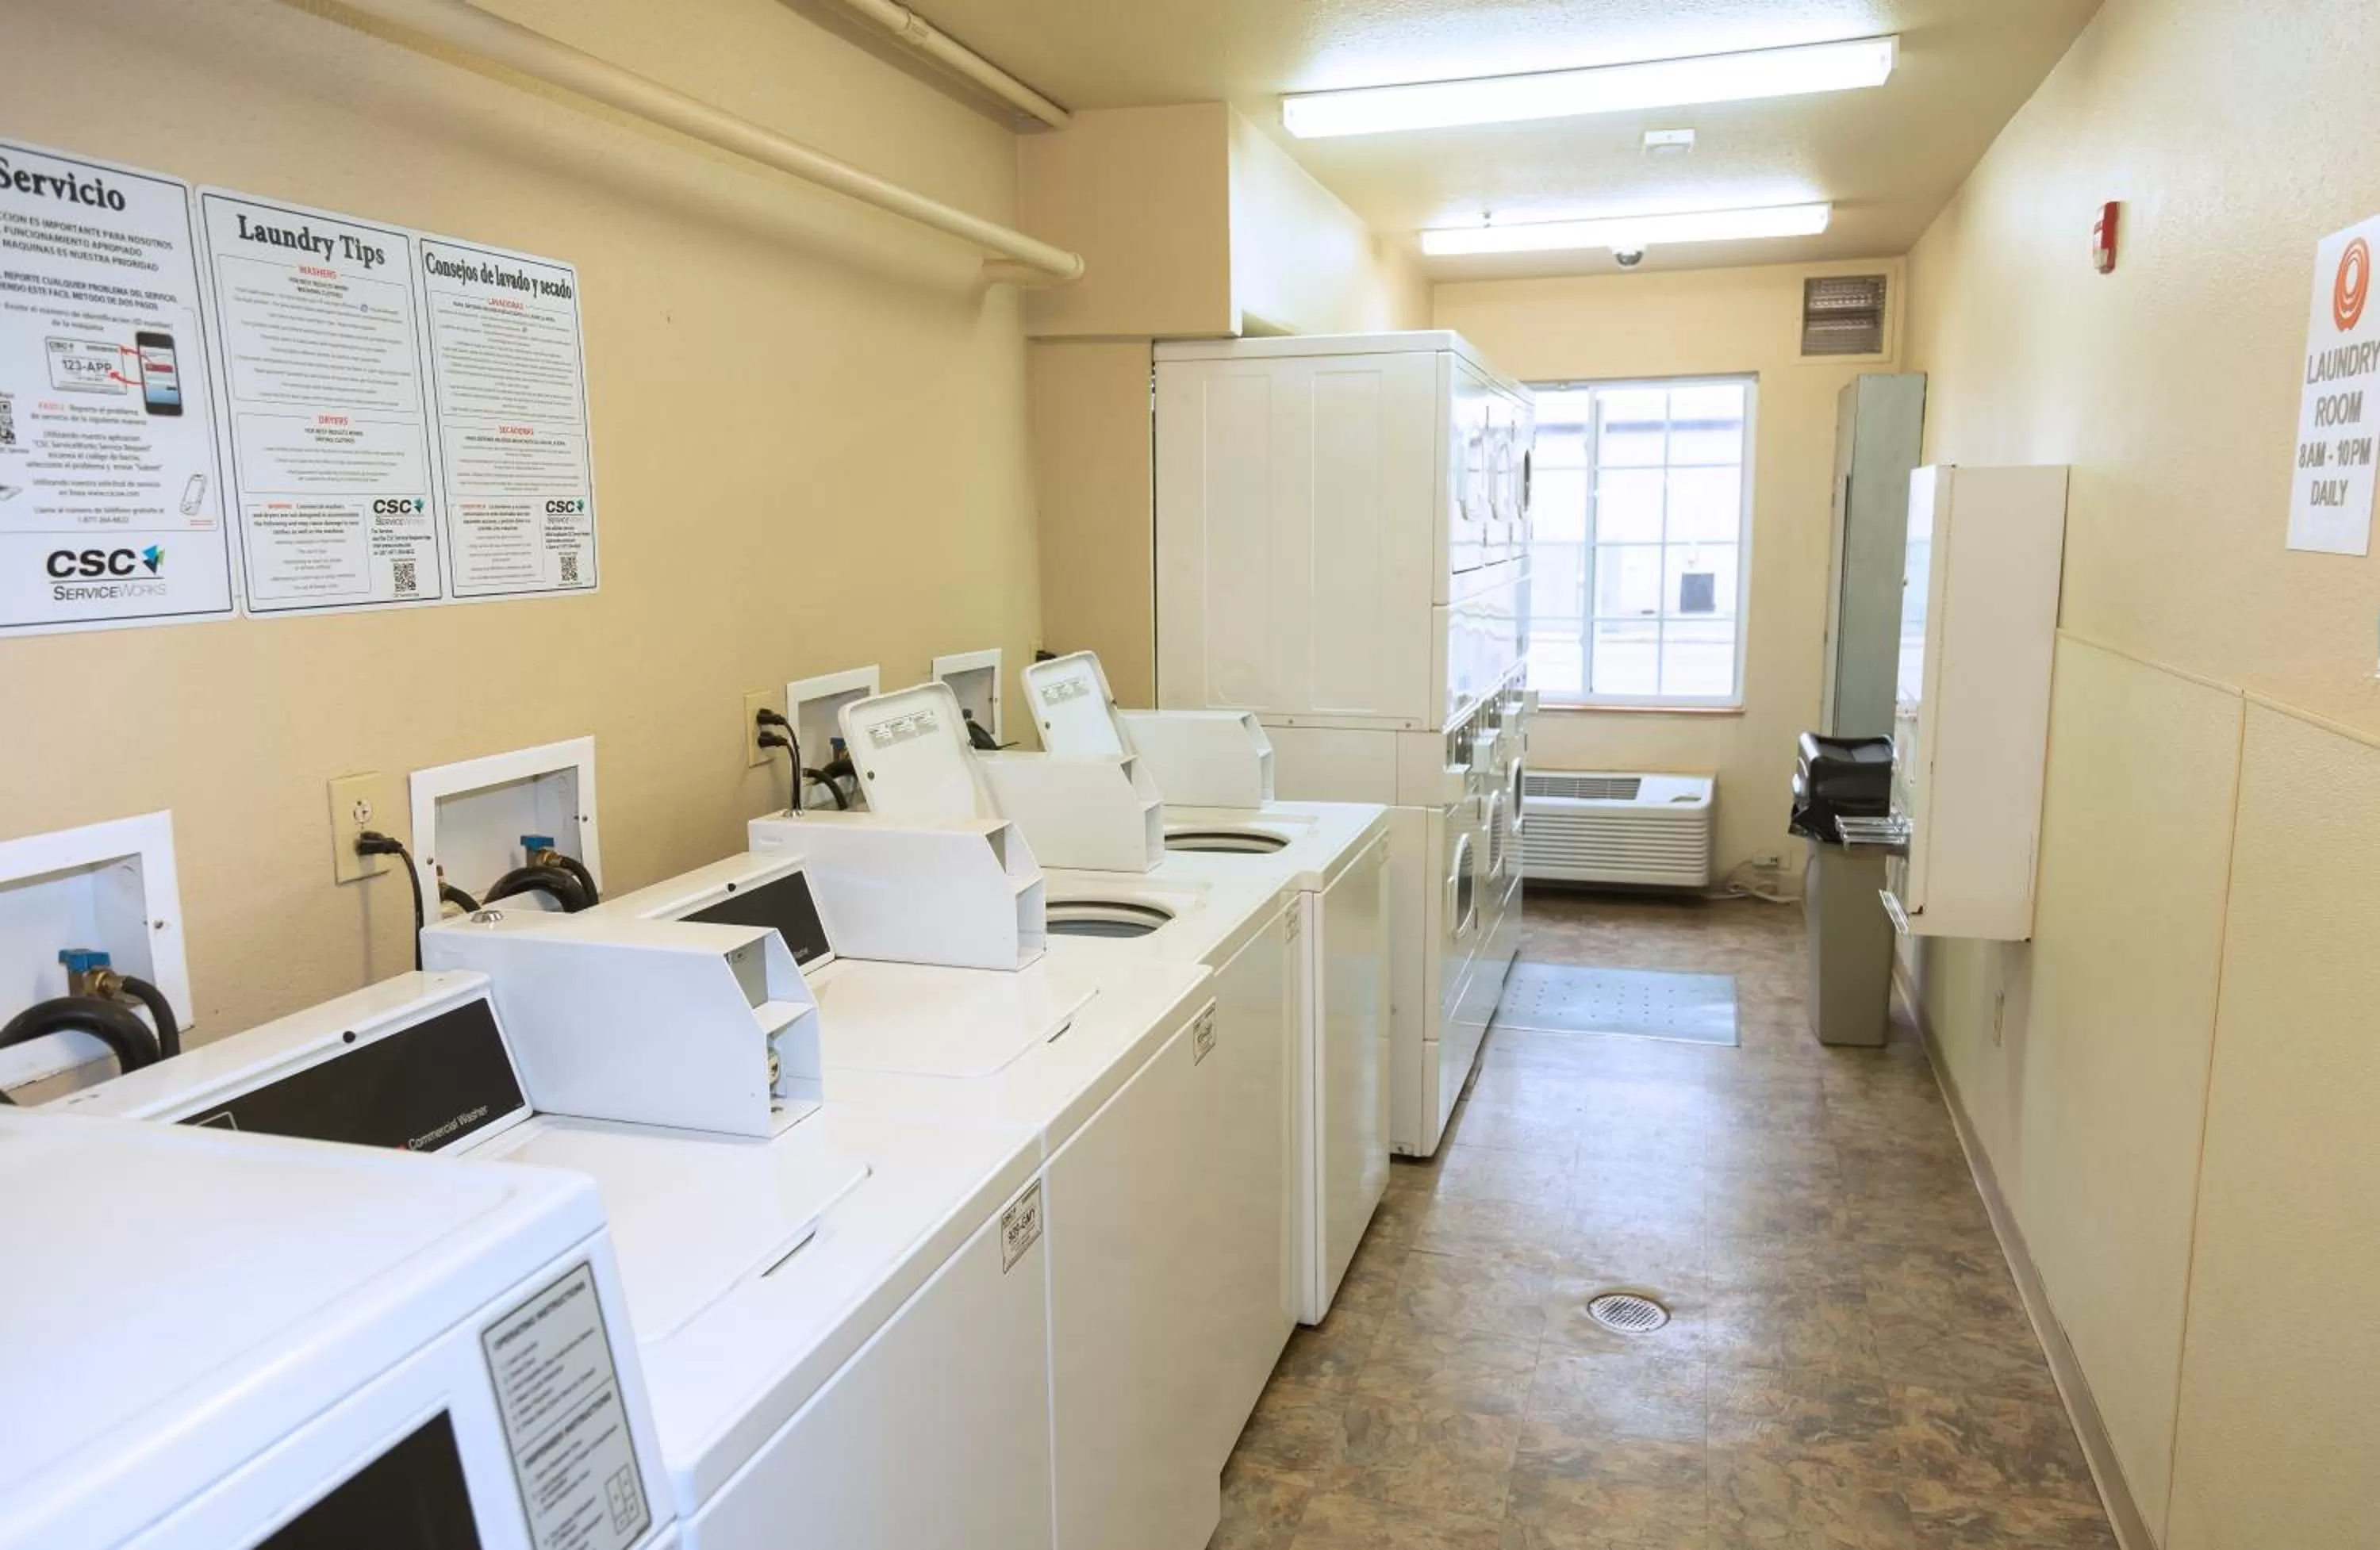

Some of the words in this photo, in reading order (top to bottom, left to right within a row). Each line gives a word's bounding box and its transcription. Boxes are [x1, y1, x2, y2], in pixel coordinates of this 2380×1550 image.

[0, 156, 125, 211] Servicio
[3, 224, 90, 247] FUNCIONAMIENTO
[42, 219, 101, 236] IMPORTANTE
[128, 235, 174, 250] NOSOTROS
[236, 213, 334, 263] Laundry
[339, 234, 385, 269] Tips
[70, 250, 110, 262] NUESTRA
[425, 252, 478, 286] Consejos
[481, 263, 493, 286] de
[495, 265, 530, 292] lavado
[532, 278, 538, 298] y
[541, 279, 572, 299] secado
[2306, 340, 2380, 384] LAUNDRY
[2315, 390, 2363, 428] ROOM
[2298, 441, 2326, 468] 8AM
[2337, 438, 2372, 466] 10PM
[373, 499, 412, 514] CSC
[546, 501, 575, 513] CSC
[2310, 478, 2348, 506] DAILY
[47, 549, 136, 577] CSC
[409, 1117, 458, 1150] Commercial
